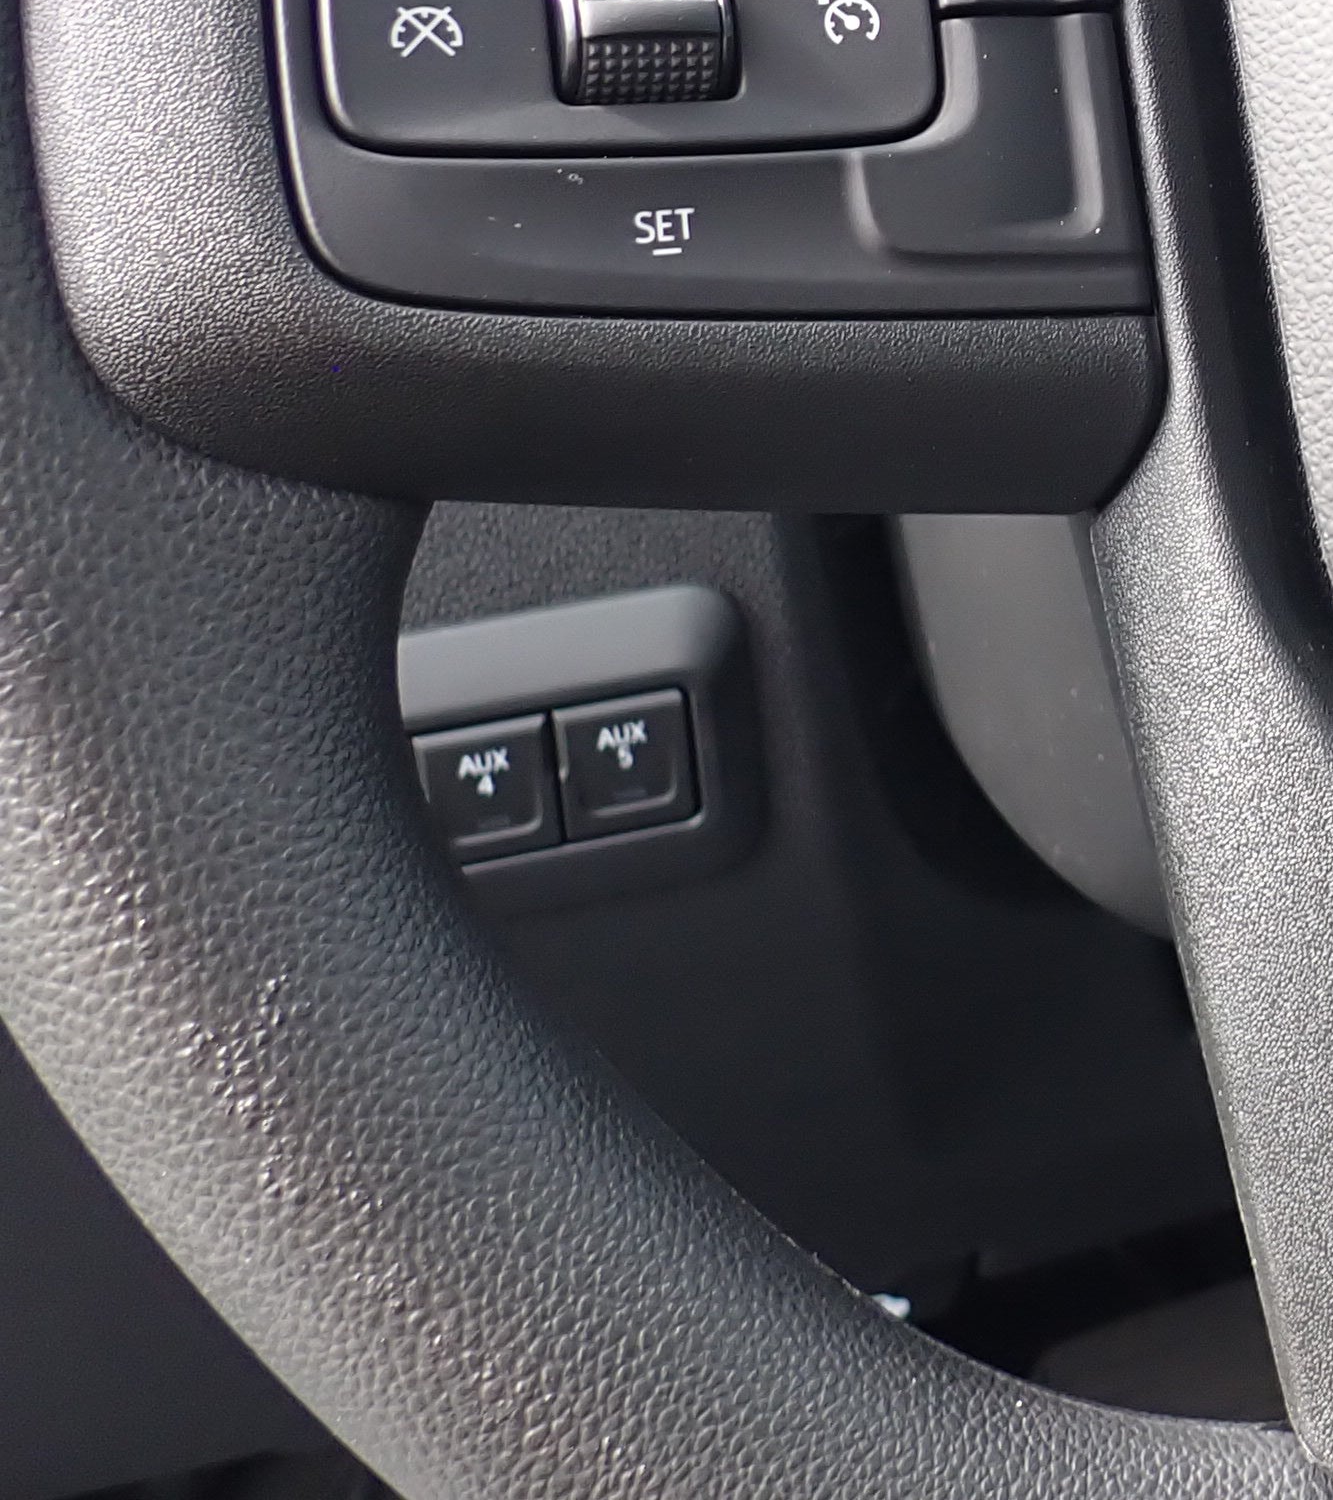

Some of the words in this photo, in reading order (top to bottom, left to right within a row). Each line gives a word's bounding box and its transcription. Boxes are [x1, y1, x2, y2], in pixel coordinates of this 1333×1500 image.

[634, 207, 695, 244] SET
[597, 719, 648, 752] AUX
[457, 747, 510, 780] AUX
[476, 775, 495, 798] 4
